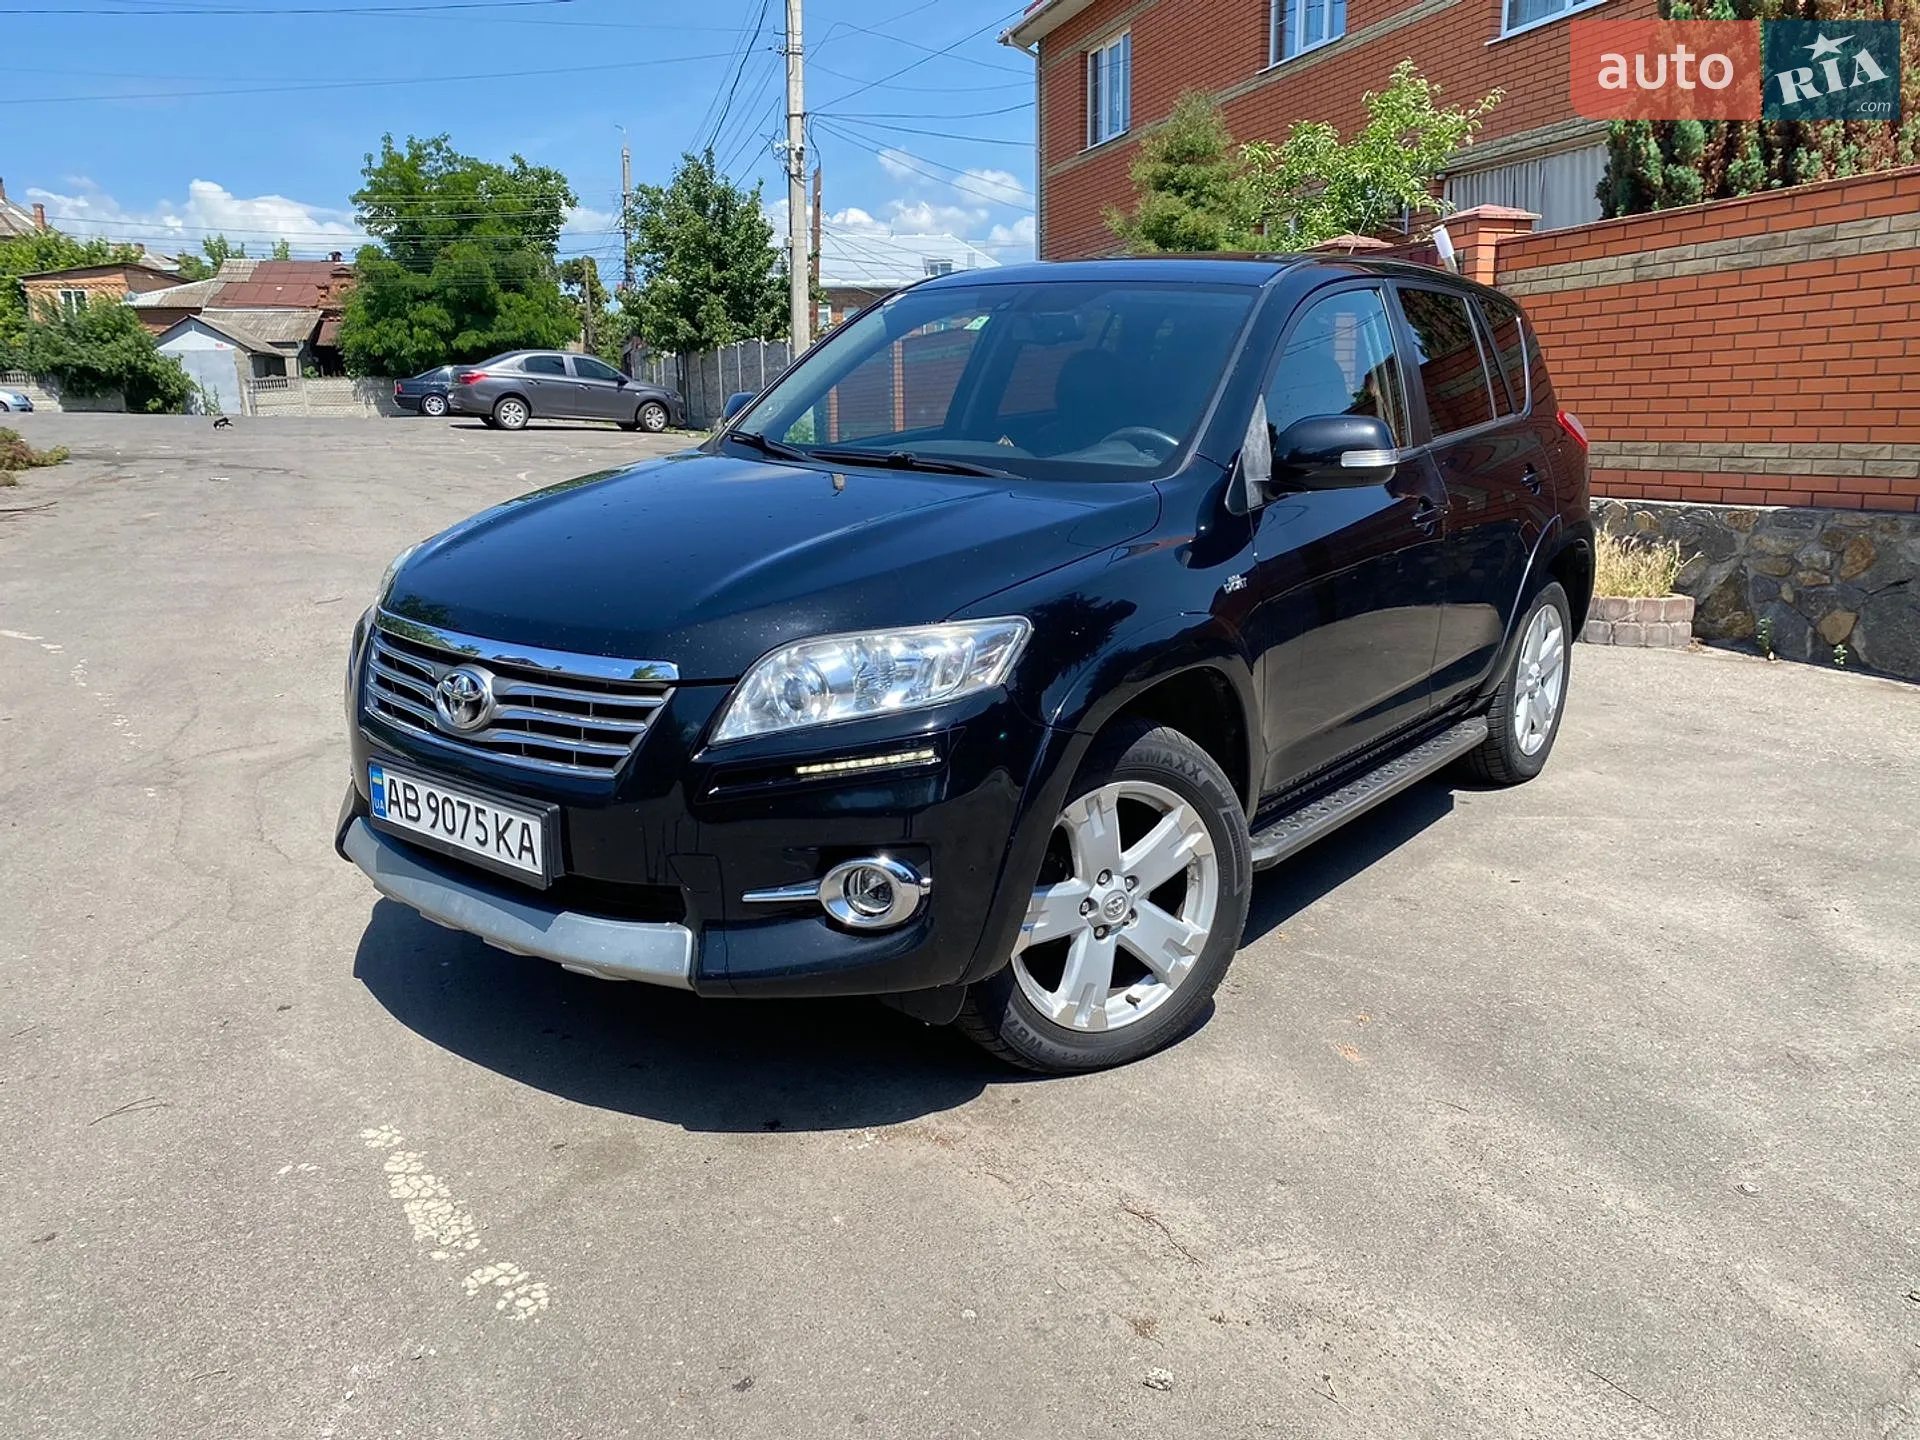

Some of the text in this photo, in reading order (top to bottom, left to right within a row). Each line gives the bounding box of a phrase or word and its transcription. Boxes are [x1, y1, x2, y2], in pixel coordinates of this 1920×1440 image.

[374, 797, 386, 811] UA
[387, 778, 538, 866] AB 9075 KA
